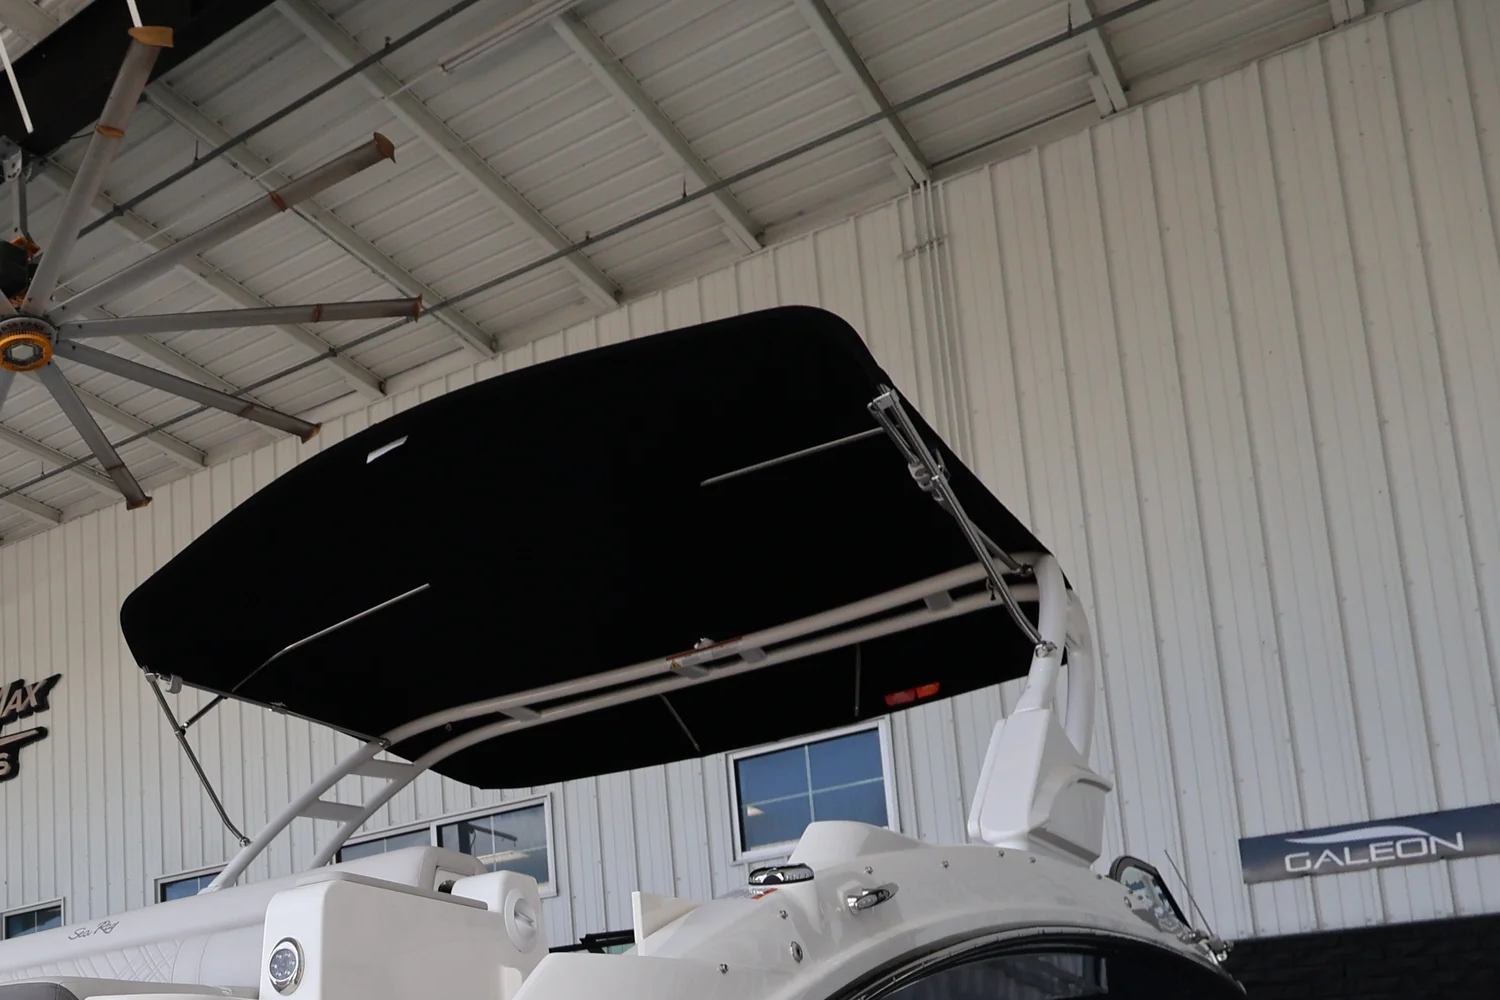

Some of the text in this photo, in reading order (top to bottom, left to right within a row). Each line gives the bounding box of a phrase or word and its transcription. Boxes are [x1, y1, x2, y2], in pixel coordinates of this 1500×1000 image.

[1284, 831, 1465, 873] GALEON
[68, 920, 120, 940] Sea Ray
